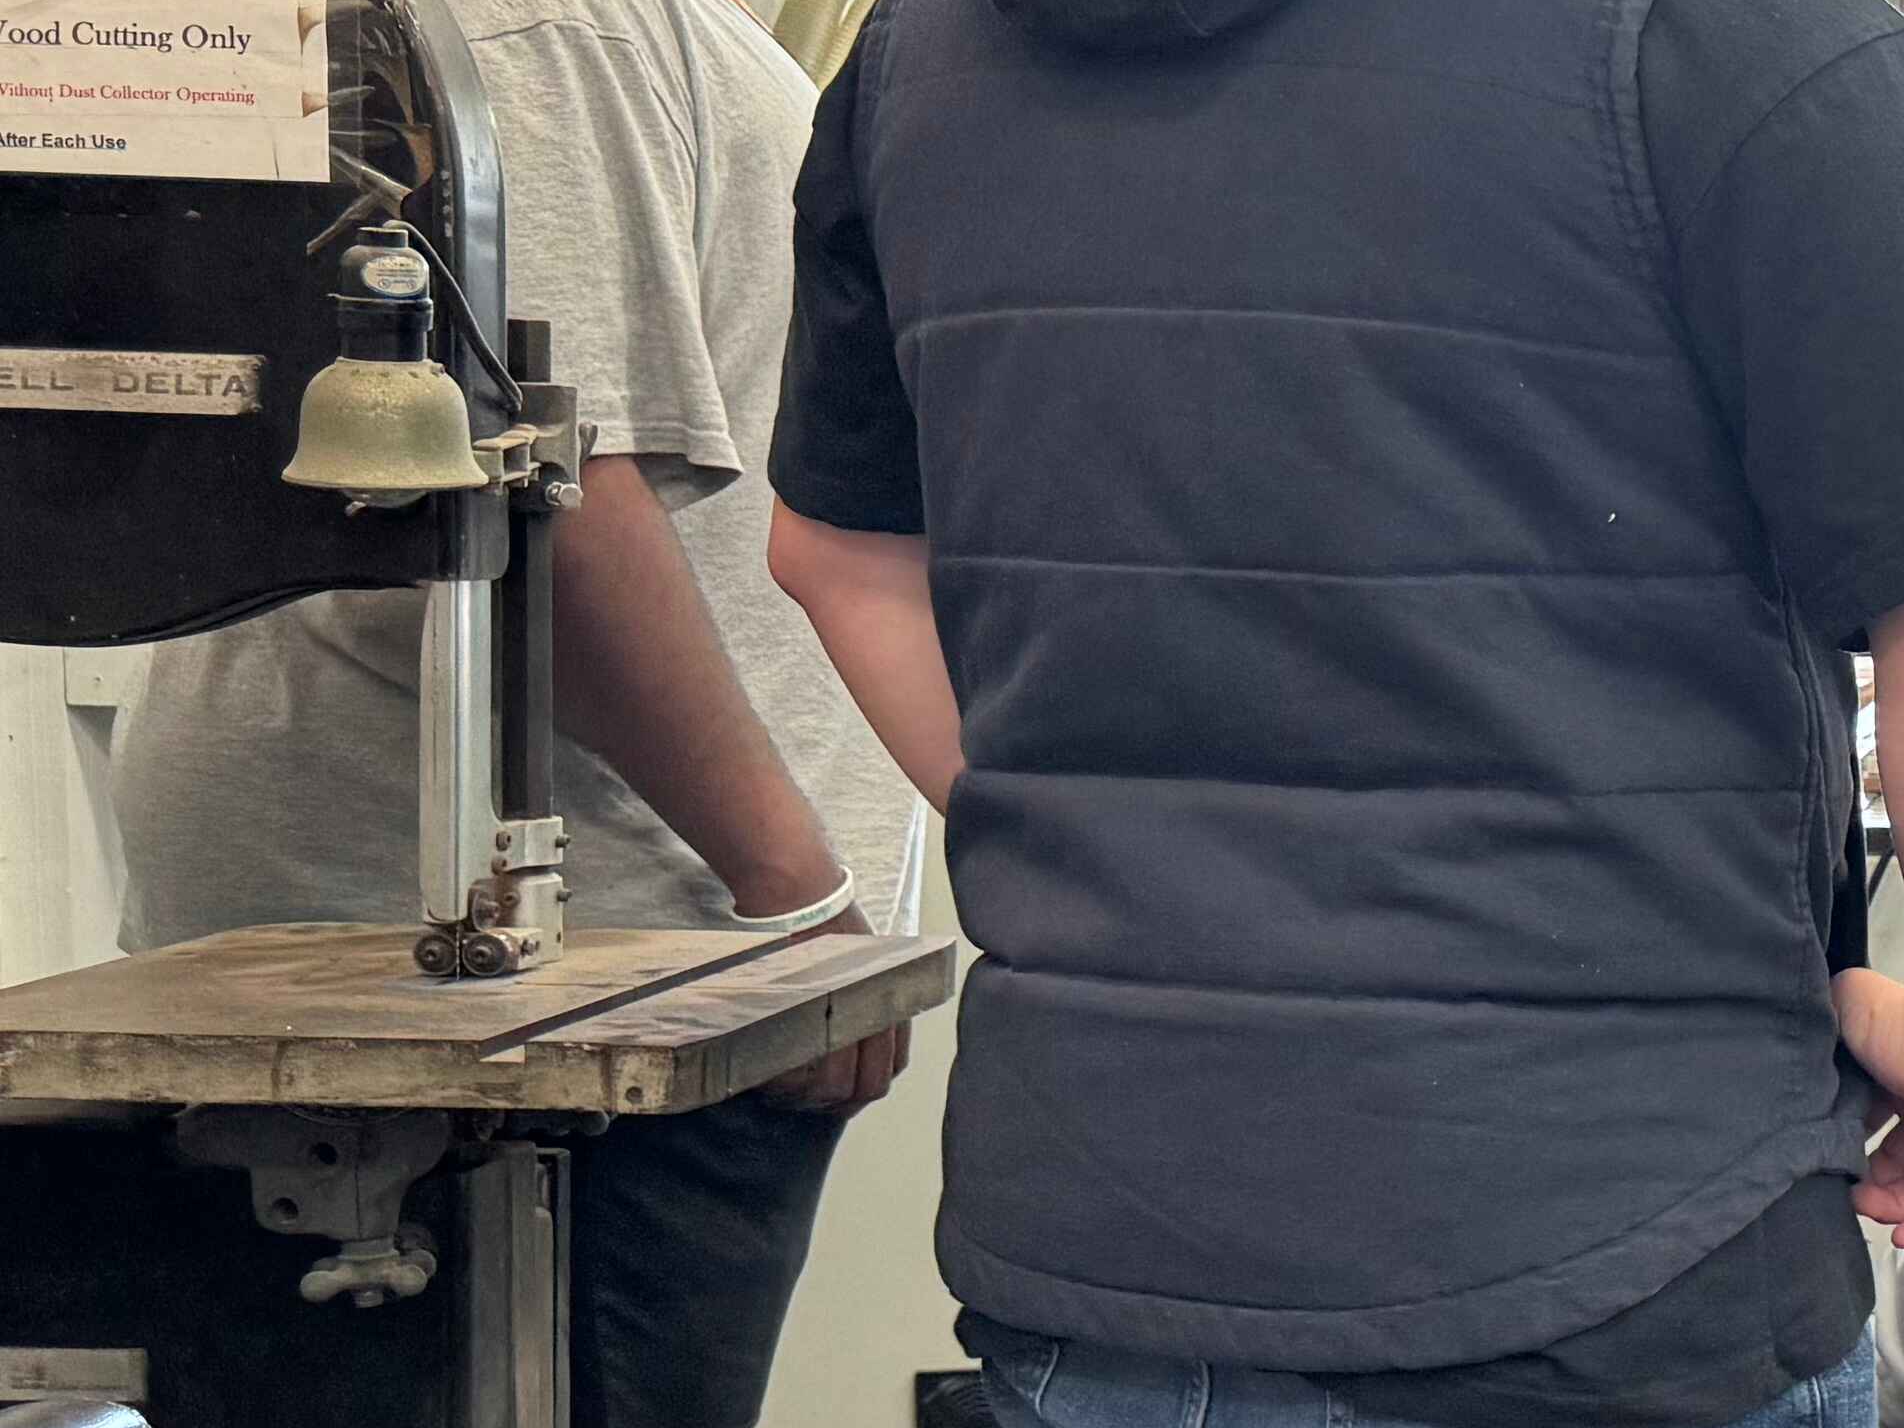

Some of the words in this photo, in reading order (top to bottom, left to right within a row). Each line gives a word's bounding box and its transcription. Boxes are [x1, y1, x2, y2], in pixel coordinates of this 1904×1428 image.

[71, 21, 174, 52] Cutting
[182, 24, 252, 55] Only
[59, 83, 97, 99] Dust
[99, 84, 171, 102] Collector
[176, 85, 258, 106] Operating
[42, 133, 87, 150] Each
[91, 134, 127, 151] Use
[112, 372, 247, 397] DELTA
